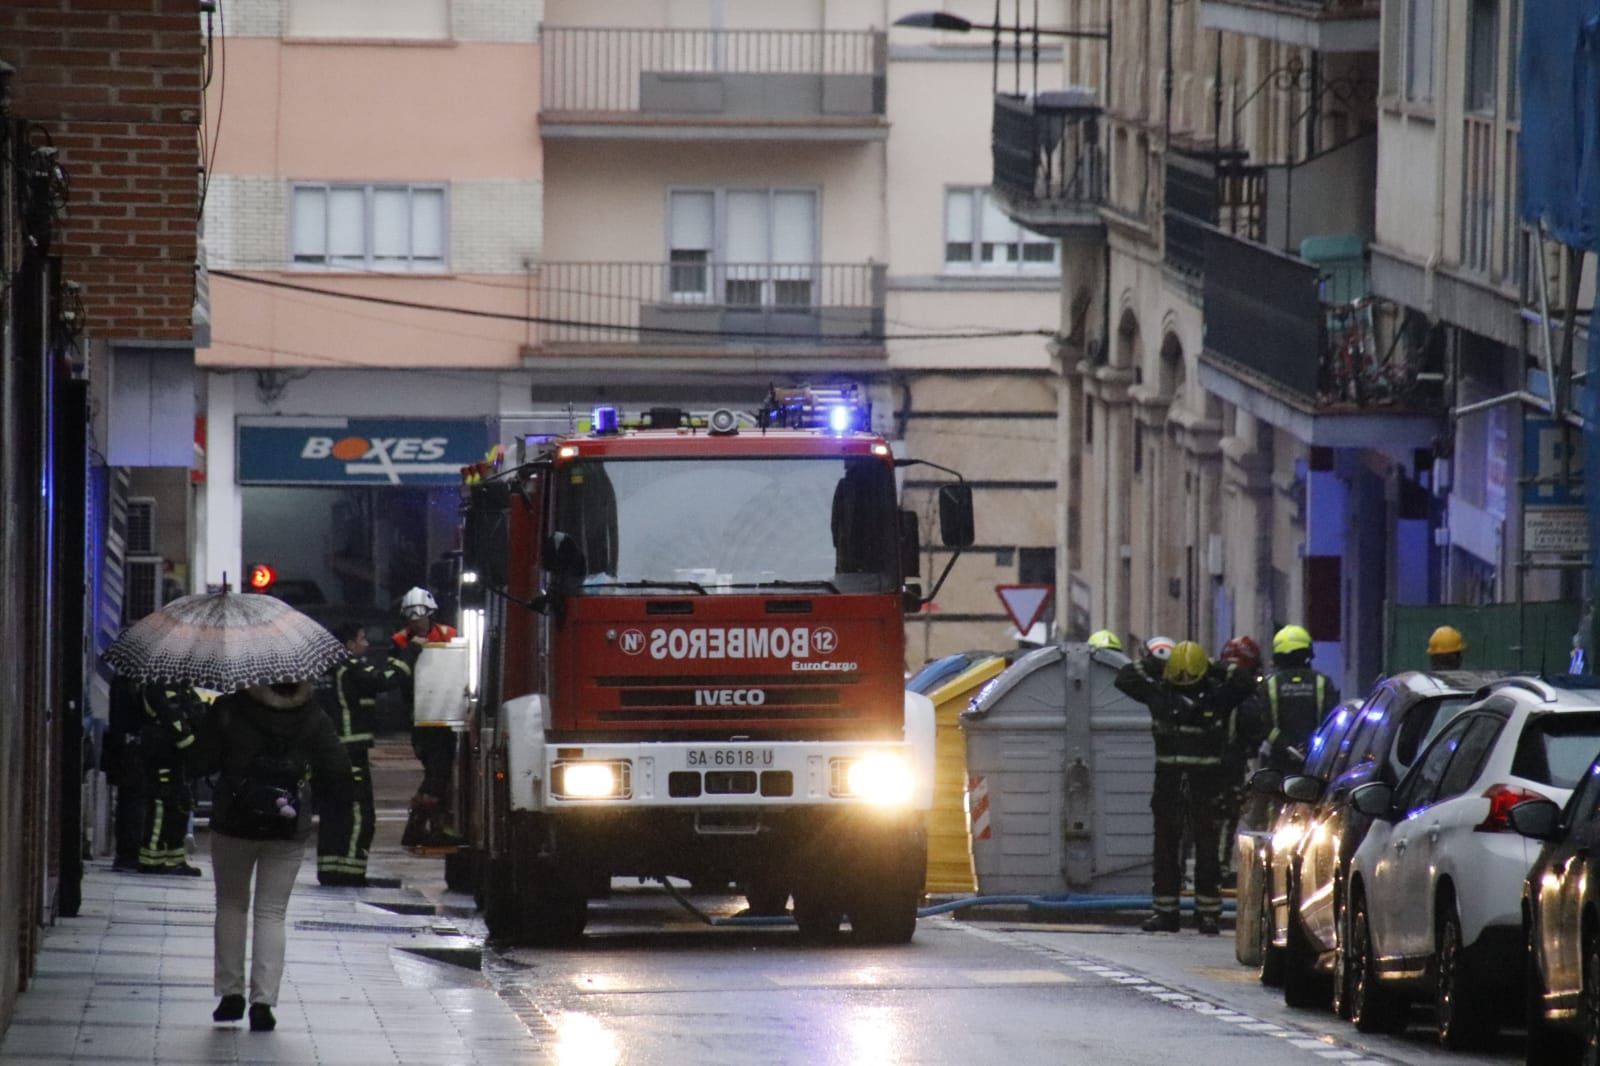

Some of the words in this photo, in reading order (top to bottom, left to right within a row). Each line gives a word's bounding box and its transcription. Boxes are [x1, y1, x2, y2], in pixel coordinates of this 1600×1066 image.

[301, 437, 449, 484] BOXES
[814, 631, 833, 650] 12
[791, 661, 858, 671] EuroCargo
[695, 689, 765, 706] IVECO
